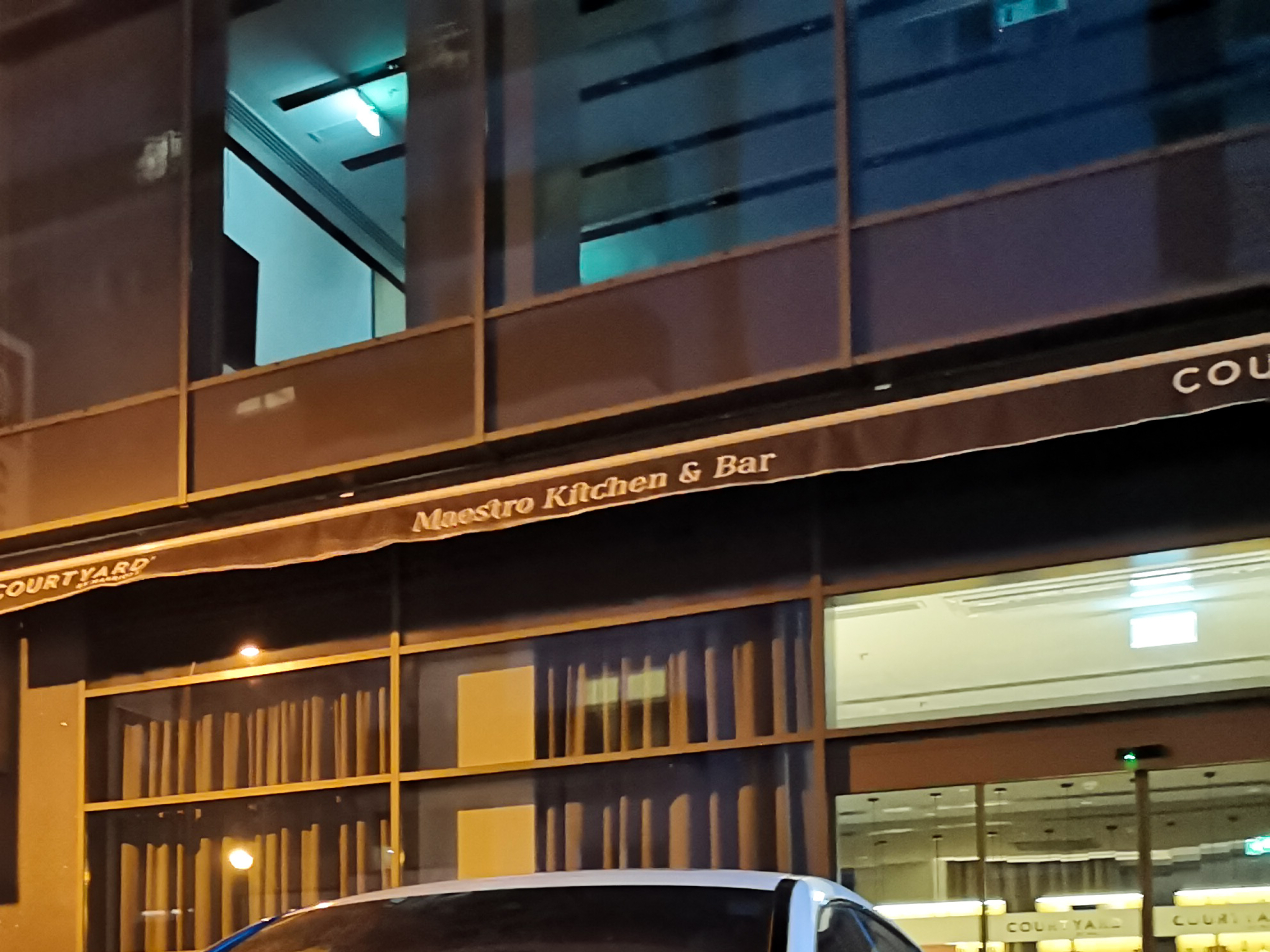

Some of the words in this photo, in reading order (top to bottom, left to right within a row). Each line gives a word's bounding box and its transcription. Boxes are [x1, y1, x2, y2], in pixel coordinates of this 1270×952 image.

[412, 496, 535, 533] Maestro
[542, 471, 668, 510] Kitchen
[678, 460, 702, 484] &
[713, 451, 778, 480] Bar
